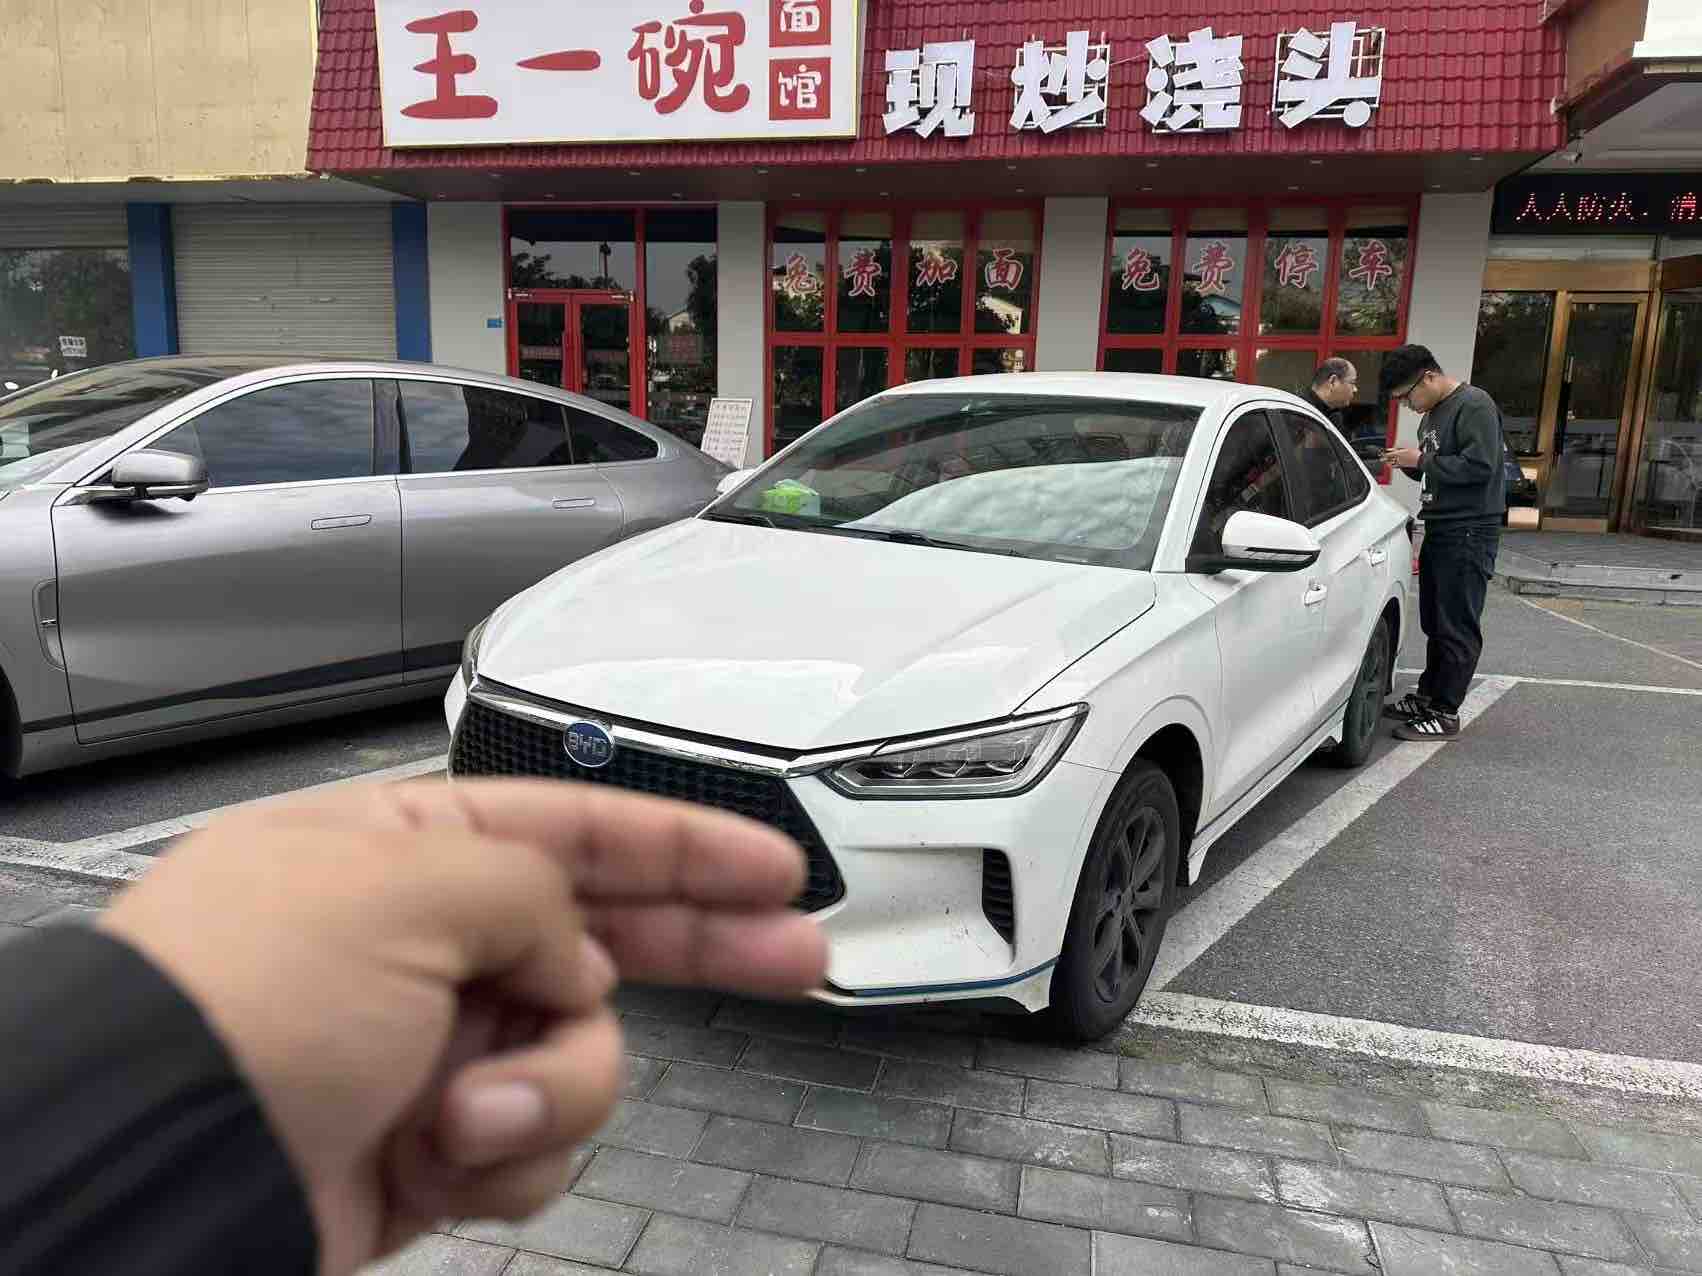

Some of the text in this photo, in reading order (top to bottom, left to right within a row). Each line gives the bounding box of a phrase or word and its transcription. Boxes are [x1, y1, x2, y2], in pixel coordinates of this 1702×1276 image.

[400, 0, 751, 119] 王一碗
[778, 0, 822, 109] 面馆
[883, 21, 1382, 138] 现炒浇头
[783, 248, 1023, 297] 免费加面
[1121, 239, 1393, 292] 免费停车
